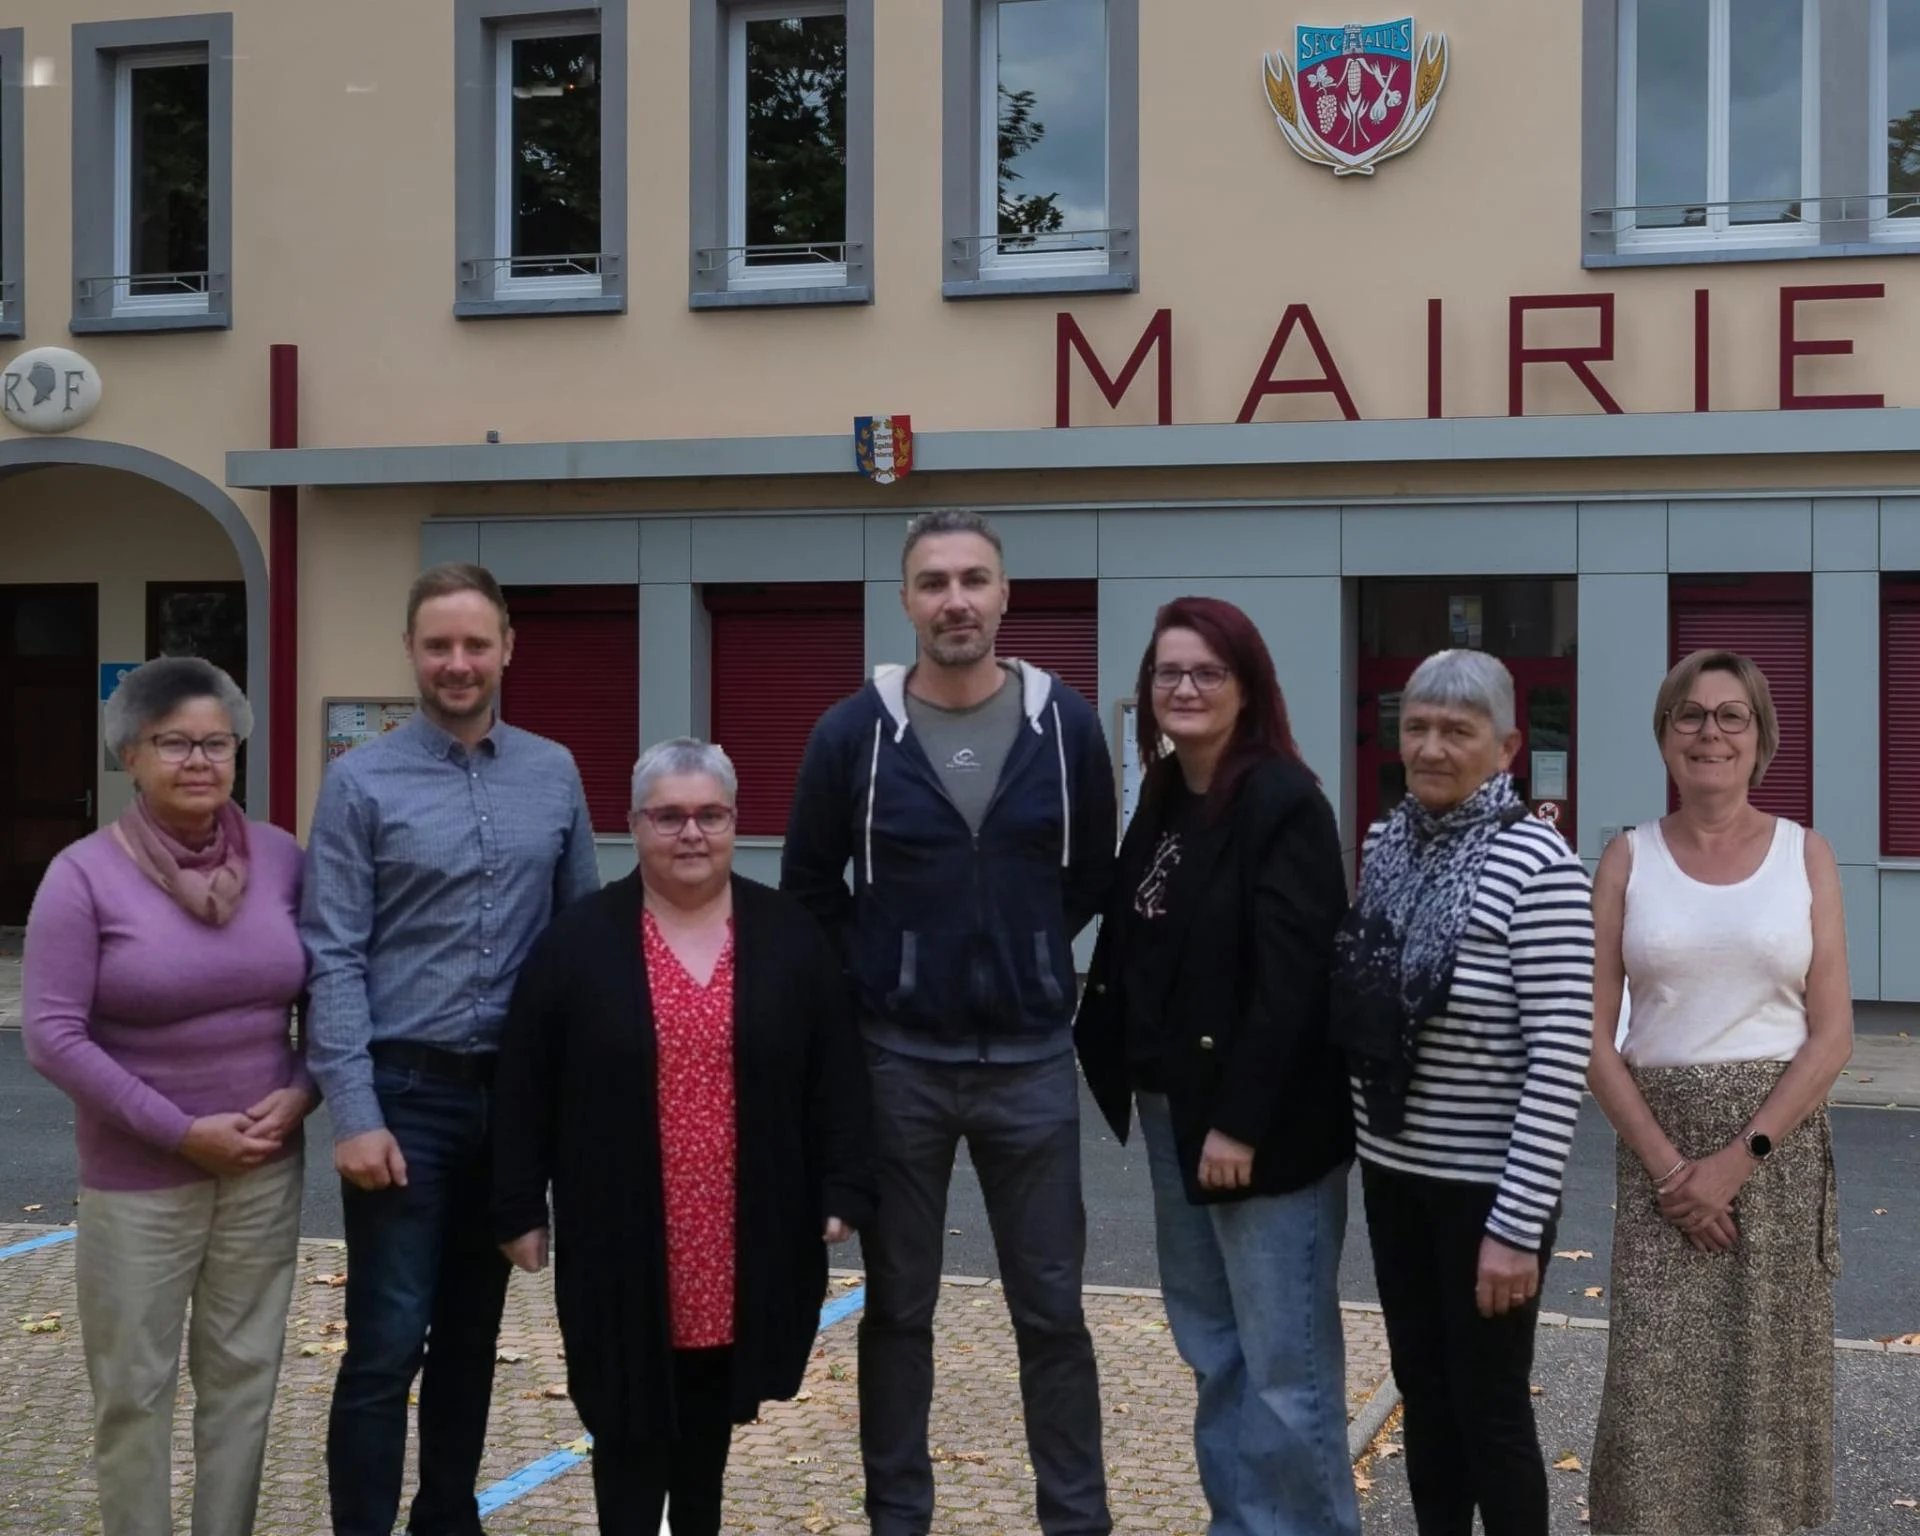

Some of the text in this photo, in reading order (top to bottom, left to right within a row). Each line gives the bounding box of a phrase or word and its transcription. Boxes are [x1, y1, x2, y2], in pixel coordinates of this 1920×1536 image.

[4, 370, 85, 413] R F
[1056, 283, 1885, 428] MAIRIE
